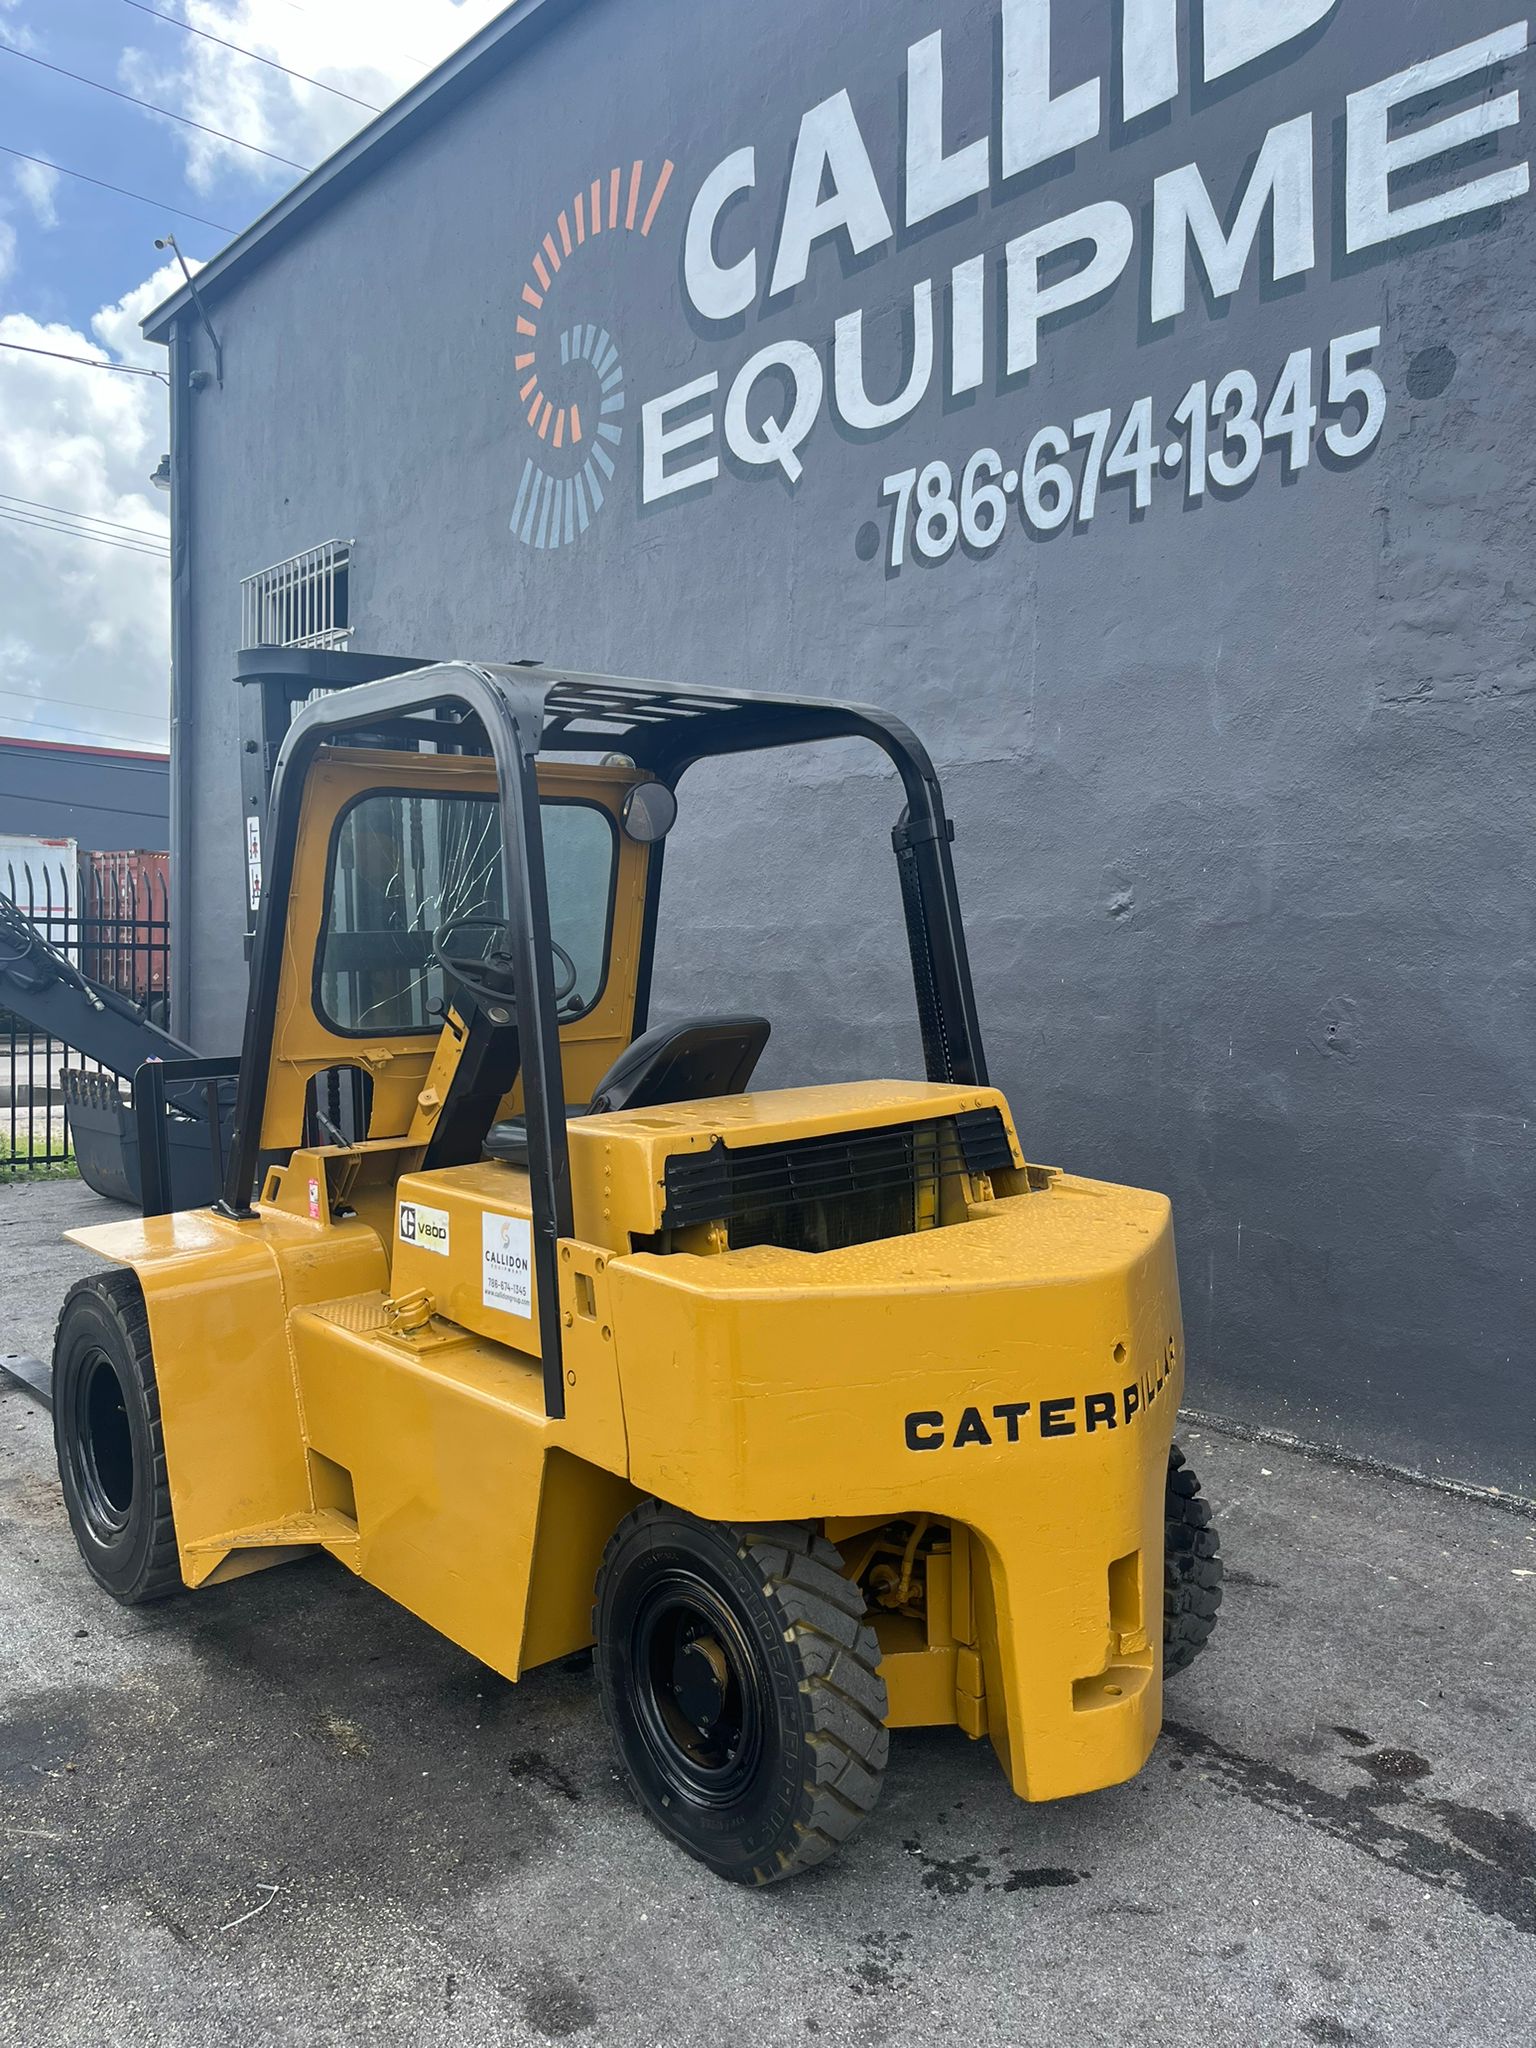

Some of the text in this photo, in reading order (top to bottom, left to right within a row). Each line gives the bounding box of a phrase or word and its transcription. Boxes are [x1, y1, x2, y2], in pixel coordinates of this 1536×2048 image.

[642, 20, 1530, 505] EQUIPME
[418, 1222, 447, 1239] V80D
[485, 1250, 528, 1271] CALLIDON
[488, 1277, 527, 1297] 786-674-1345
[484, 1289, 530, 1306] www.callidongroup.com
[904, 1335, 1177, 1452] CATERPILLAR
